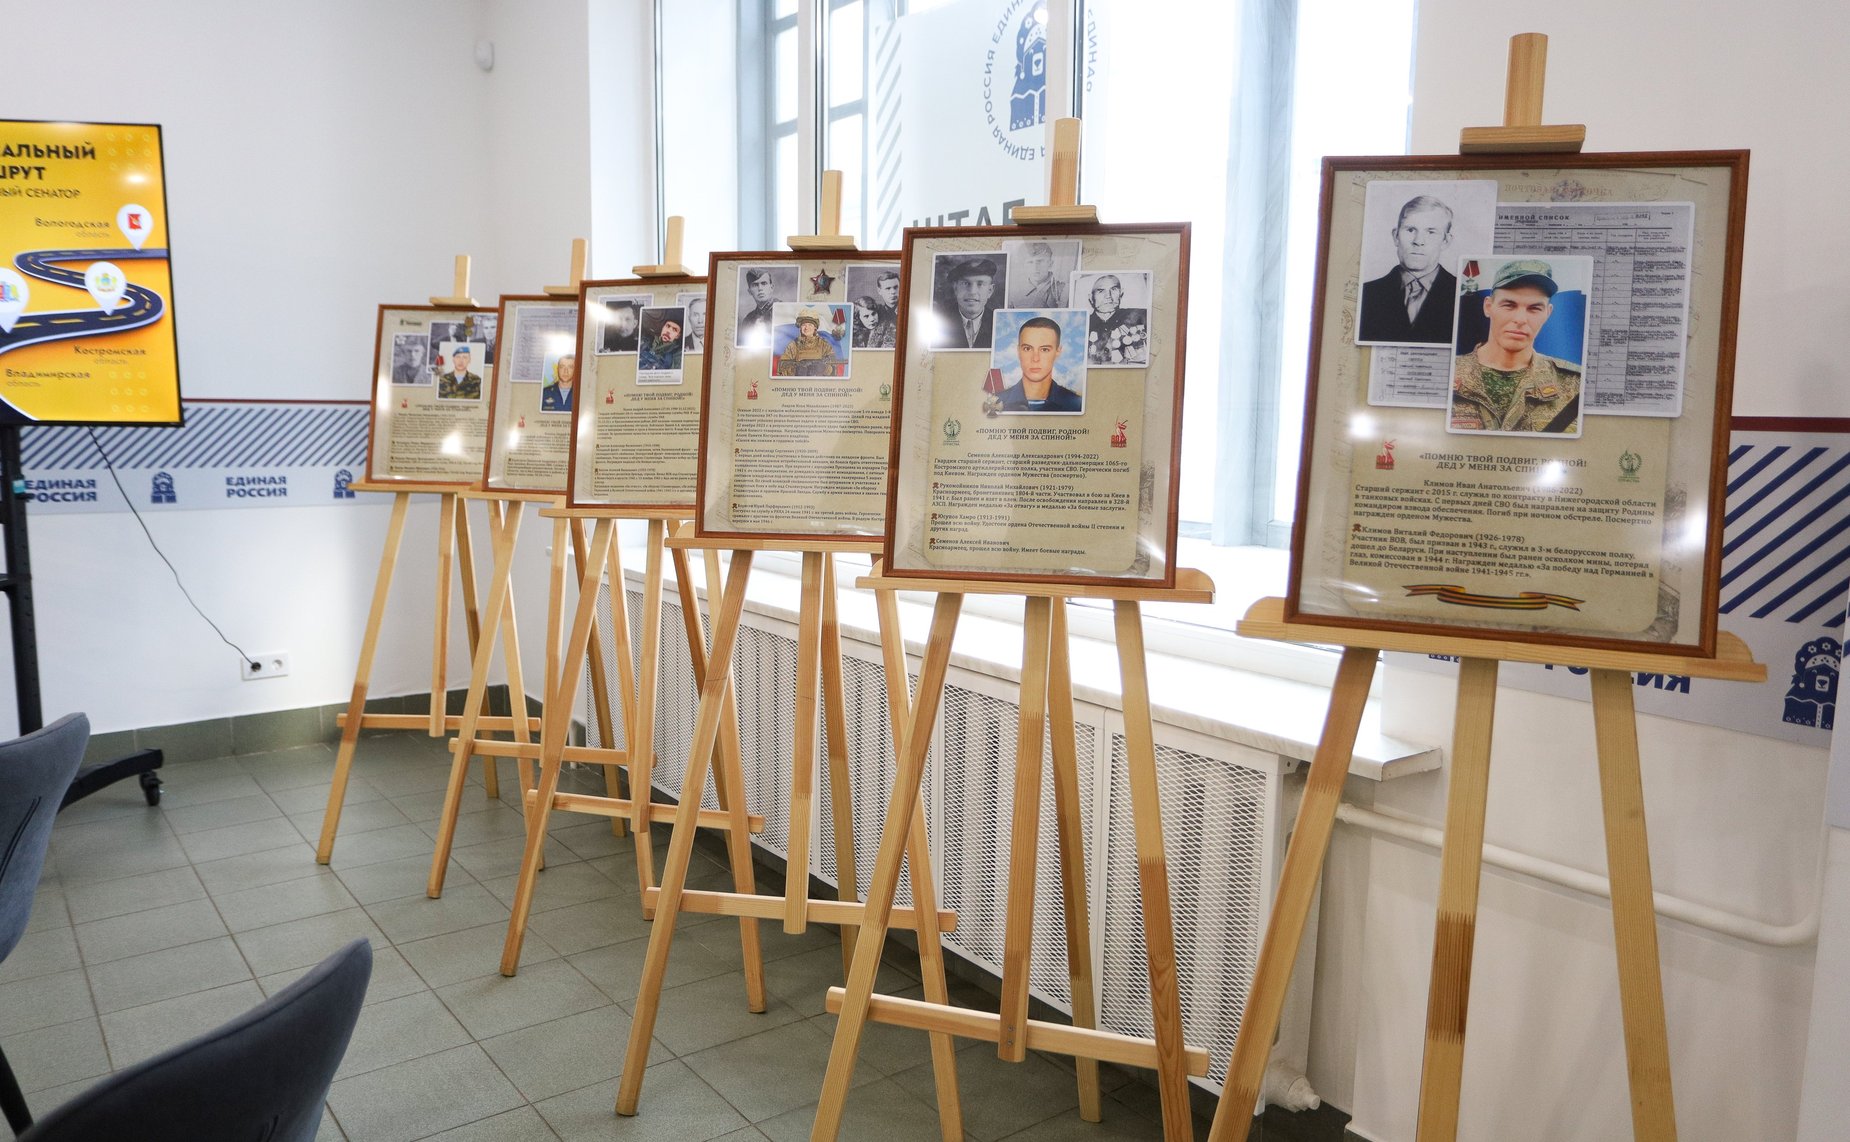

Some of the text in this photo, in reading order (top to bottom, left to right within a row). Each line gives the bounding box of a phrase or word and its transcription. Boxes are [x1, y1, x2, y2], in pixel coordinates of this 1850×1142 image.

[26, 188, 80, 198] СЕНАТОР
[1420, 453, 1538, 466] «ПОМНЮ ТВОЙ ПОДВИГ,
[1436, 462, 1457, 470] ДЕД
[226, 476, 287, 486] ЕДИНАЯ
[30, 492, 97, 502] ОССИЯ
[226, 488, 288, 498] РОССИЯ
[1356, 485, 1390, 494] Старший
[1391, 488, 1424, 496] сержант
[1460, 491, 1489, 500] служил
[1554, 496, 1620, 507] Нижегородской
[1622, 500, 1656, 508] области
[1354, 502, 1402, 511] командиром
[1442, 499, 1471, 507] первых
[1472, 500, 1492, 508] дней
[1531, 504, 1575, 513] направлен
[1588, 507, 1620, 516] защиту
[1622, 508, 1655, 518] Родины
[1354, 510, 1395, 519] награжден
[1397, 513, 1430, 522] орденом
[1394, 528, 1427, 536] Виталий
[1430, 530, 1473, 540] Федорович
[1476, 533, 1525, 543] (1926-1978)
[1350, 544, 1376, 552] дошел
[1428, 548, 1444, 556] При
[1445, 550, 1498, 560] наступлении
[1518, 555, 1543, 563] ранен
[1545, 557, 1584, 565] осколком
[1614, 561, 1649, 570] потерял
[1554, 547, 1607, 558] белорусском
[1350, 559, 1381, 568] Великой
[1384, 561, 1444, 572] Отечественной
[1472, 567, 1514, 577] 1941-1945
[1452, 558, 1496, 568] Награжден
[1498, 562, 1535, 571] медалью
[1552, 564, 1581, 574] победу
[1601, 568, 1647, 578] Германией
